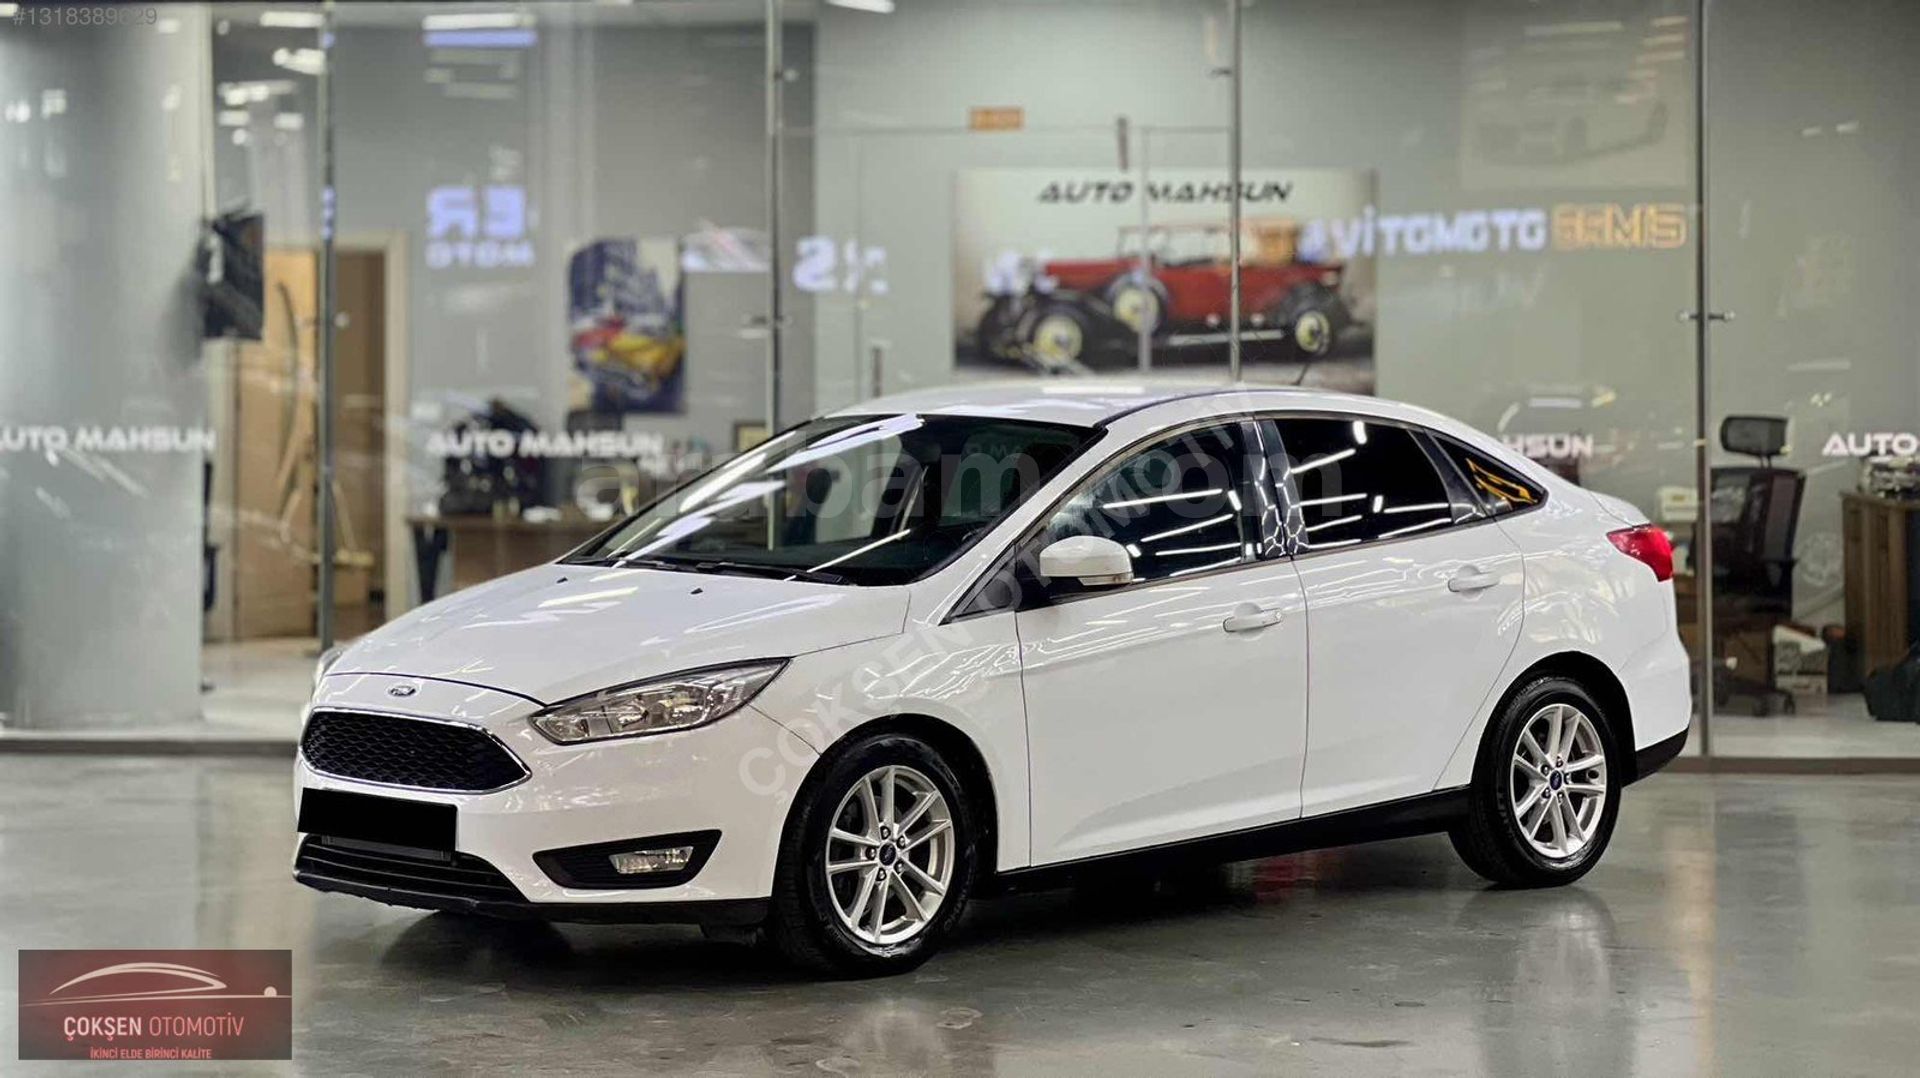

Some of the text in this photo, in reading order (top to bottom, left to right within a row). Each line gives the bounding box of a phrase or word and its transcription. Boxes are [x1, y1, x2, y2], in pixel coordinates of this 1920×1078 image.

[1038, 181, 1135, 204] AUTO
[0, 426, 216, 452] UTO MAHSUN
[427, 429, 665, 458] AUTO MAHSUN
[1502, 433, 1593, 458] HSUN
[1821, 432, 1918, 457] AUTO
